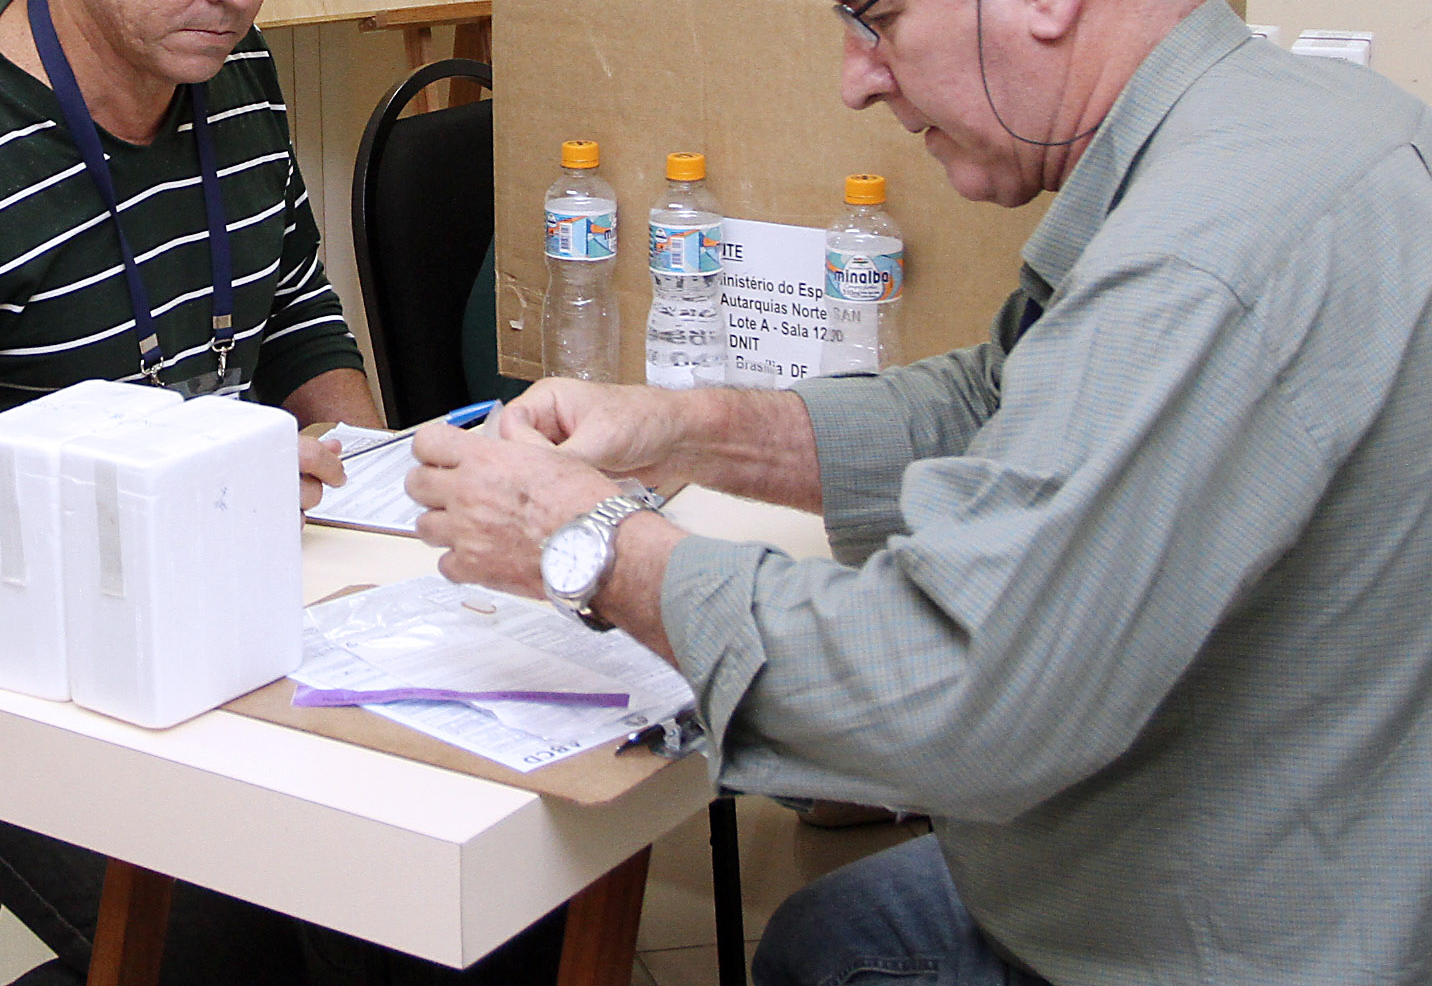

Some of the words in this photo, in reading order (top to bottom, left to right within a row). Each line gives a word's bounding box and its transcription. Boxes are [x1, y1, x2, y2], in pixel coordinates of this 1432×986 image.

[719, 272, 774, 292] inistério
[778, 280, 794, 294] do
[798, 282, 824, 301] Esp
[834, 269, 890, 285] minalba
[720, 293, 788, 314] Autarquias
[792, 302, 828, 320] Norte
[729, 313, 757, 330] Lote
[760, 318, 770, 332] A
[781, 321, 809, 338] Sala
[729, 334, 760, 351] DNIT
[791, 364, 808, 379] DF
